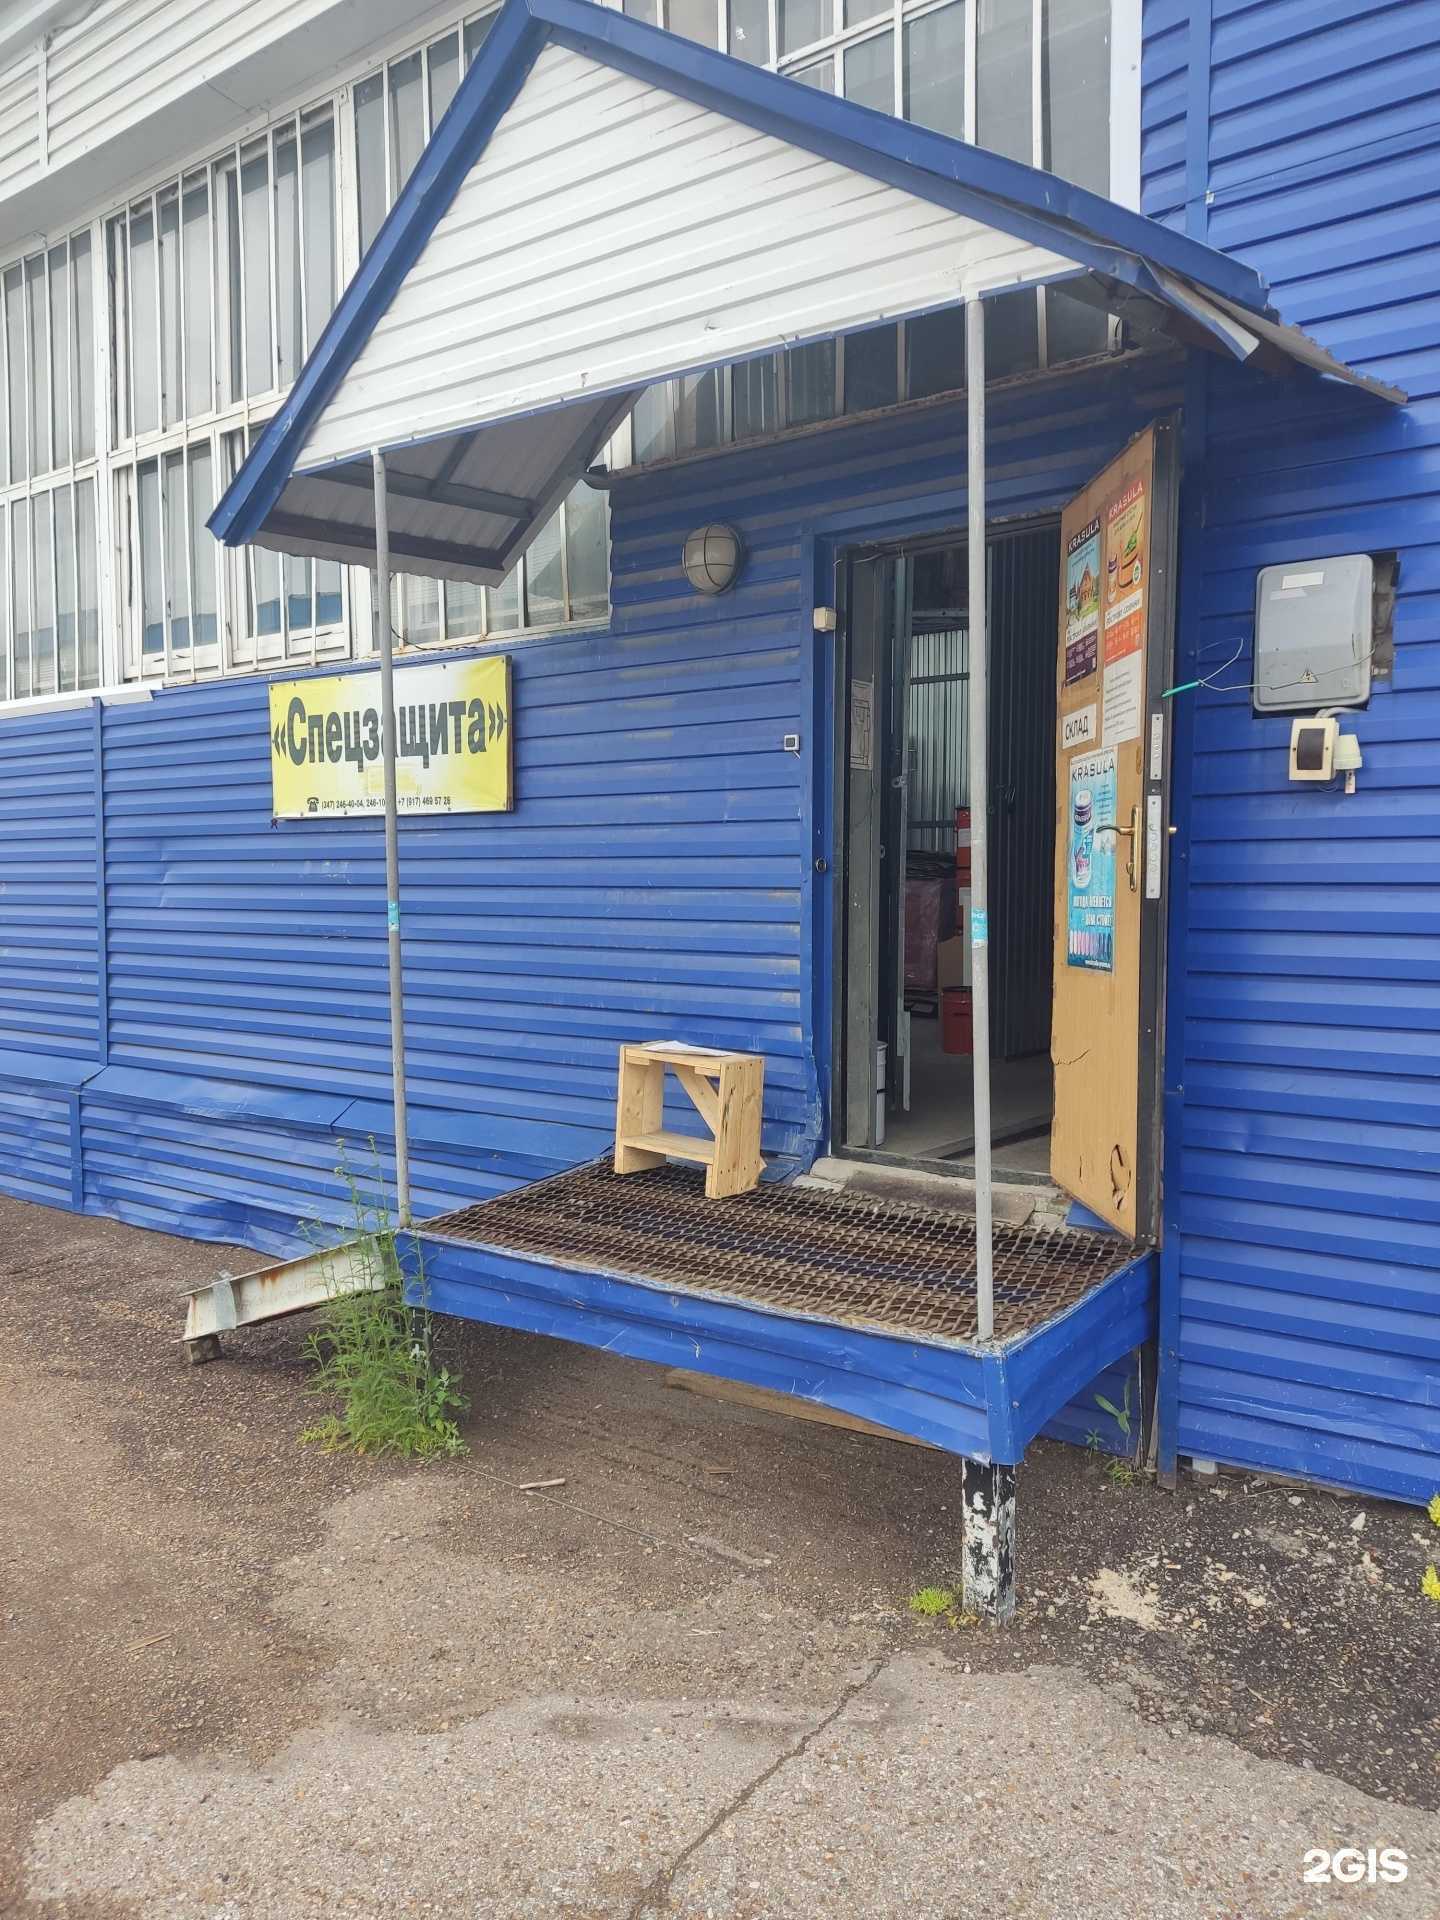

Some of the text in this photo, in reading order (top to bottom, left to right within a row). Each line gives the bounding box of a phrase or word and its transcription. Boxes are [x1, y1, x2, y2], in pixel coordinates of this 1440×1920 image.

[1109, 482, 1143, 519] KRASULA
[1069, 520, 1100, 552] KRASULA
[1065, 715, 1088, 740] СКЛАД
[1072, 758, 1114, 781] KRASULA
